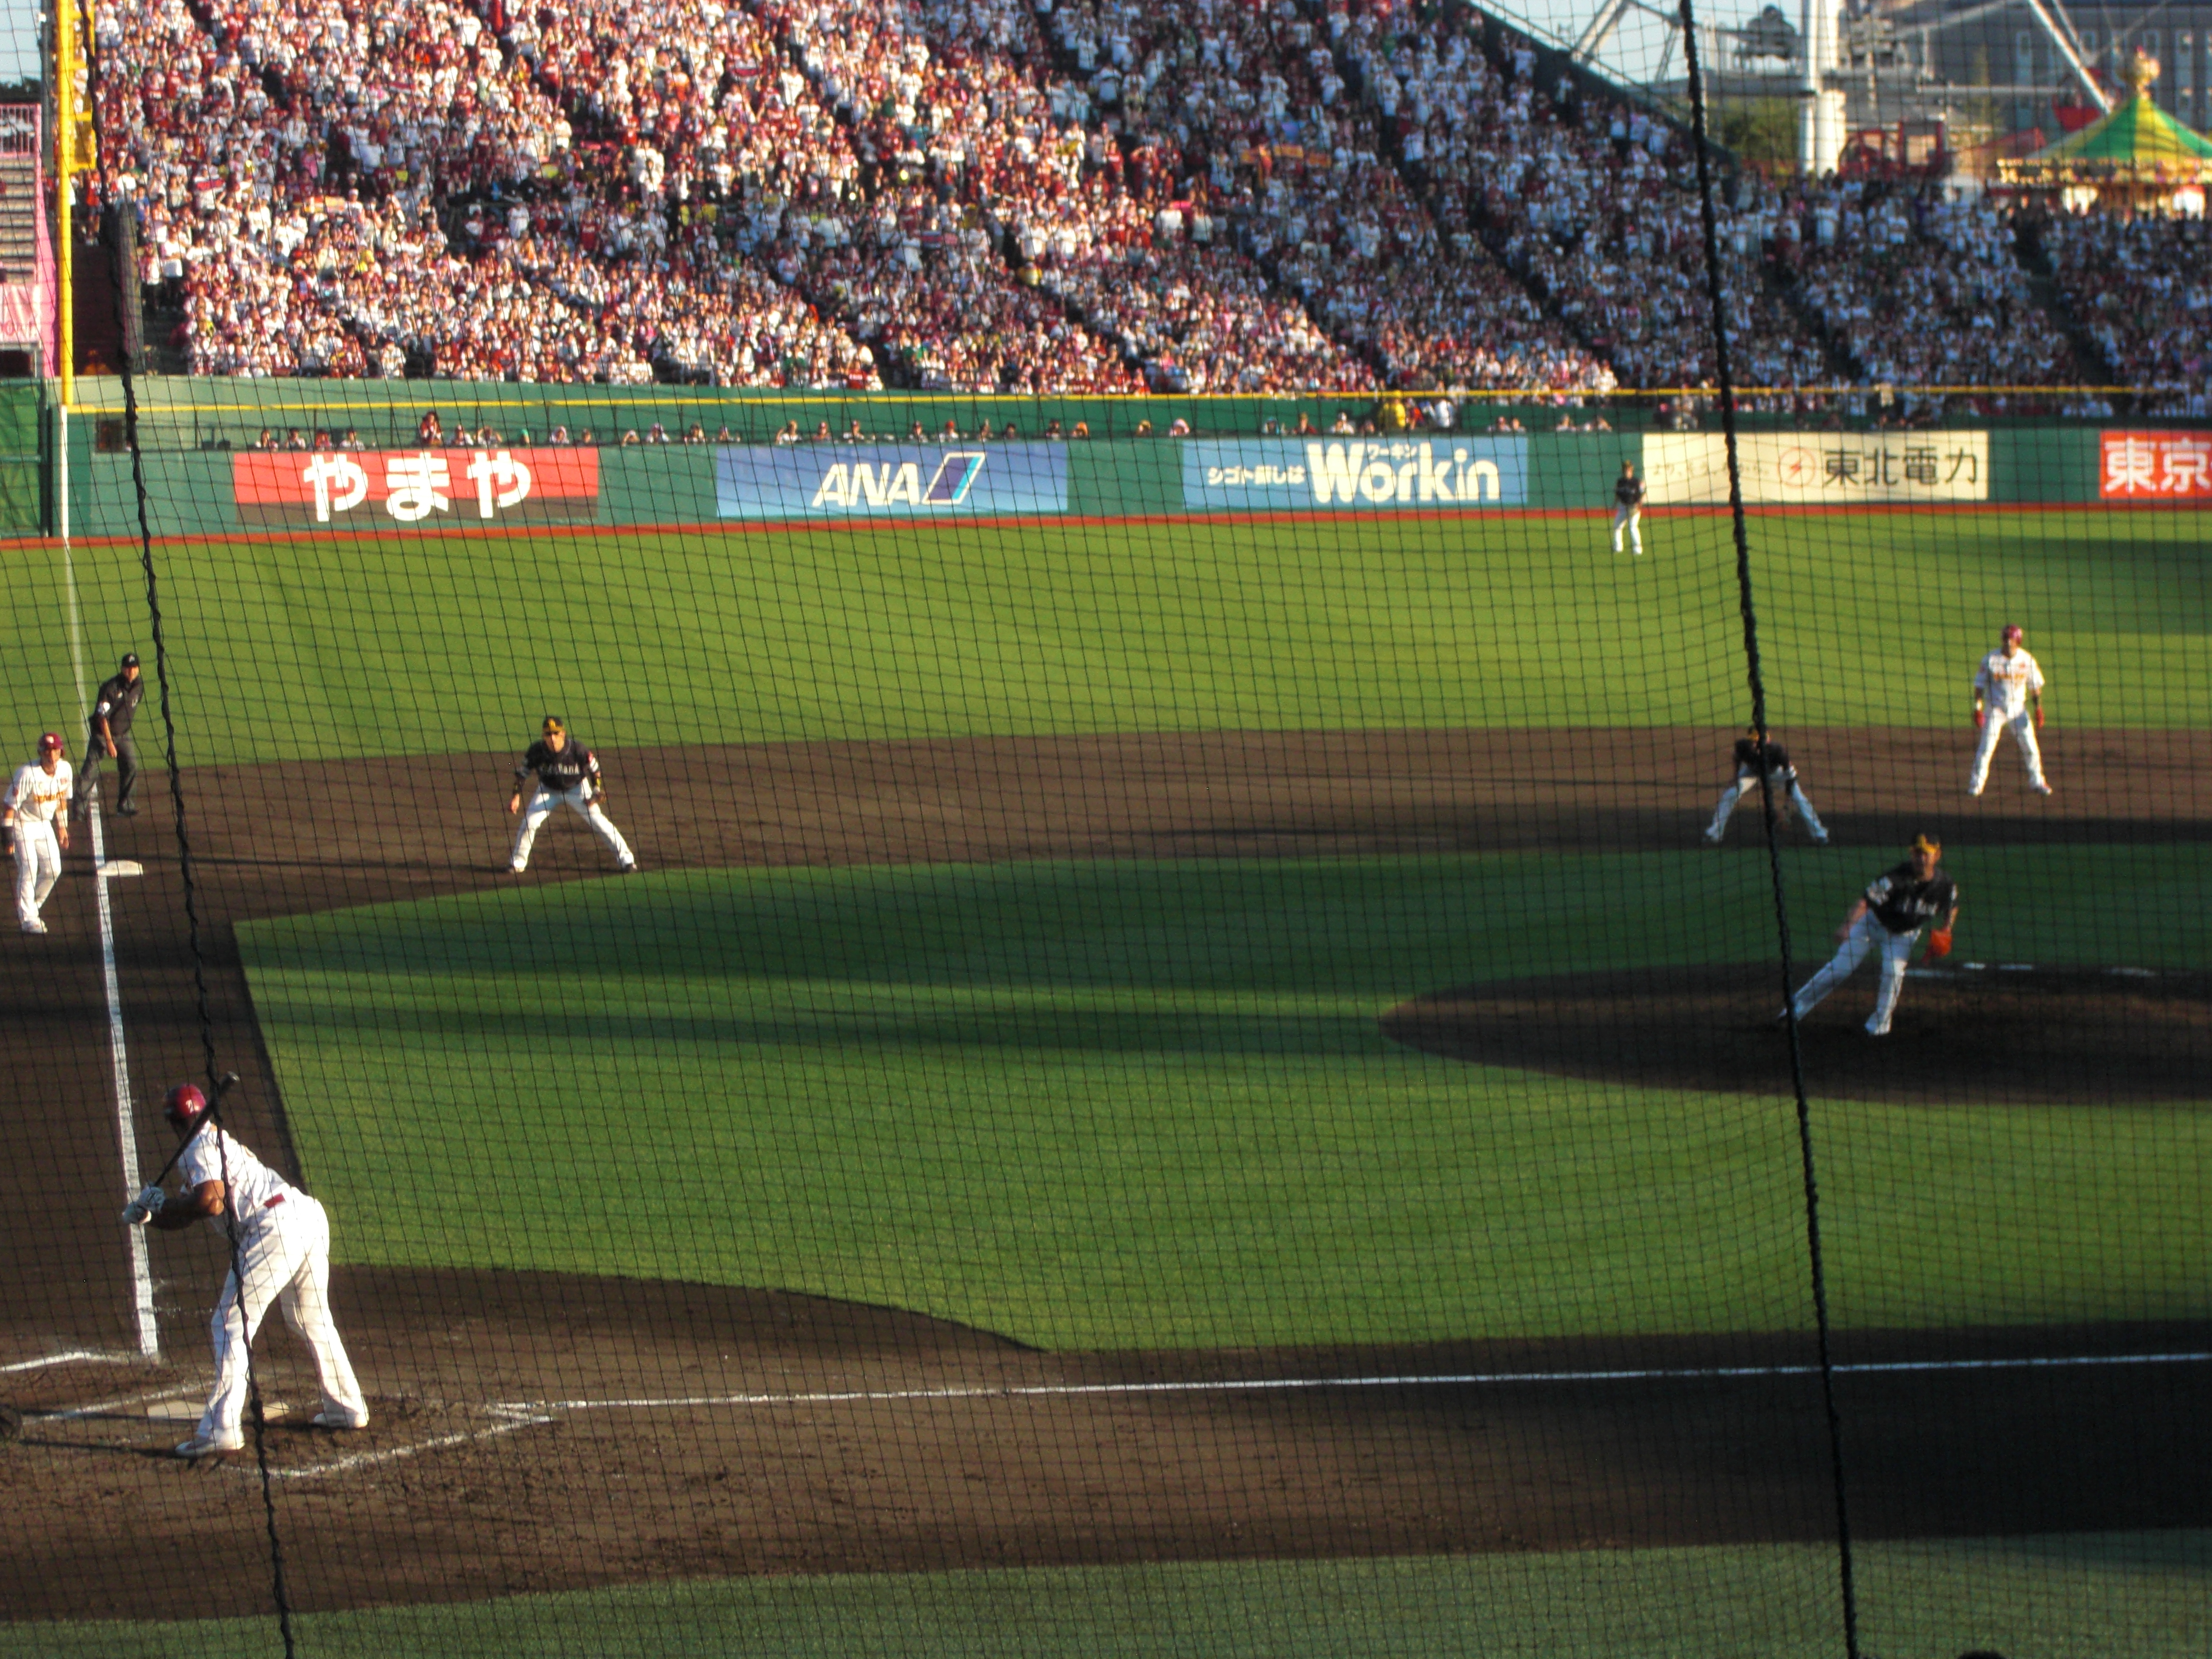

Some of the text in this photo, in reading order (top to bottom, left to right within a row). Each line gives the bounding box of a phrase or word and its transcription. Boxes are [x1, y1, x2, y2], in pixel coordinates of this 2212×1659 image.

[1307, 442, 1501, 504] Workin
[1367, 443, 1417, 460] ワーキン
[1824, 446, 1978, 486] 東北電力
[2105, 437, 2211, 493] 東京
[303, 451, 532, 523] やまや
[811, 463, 920, 506] ANA
